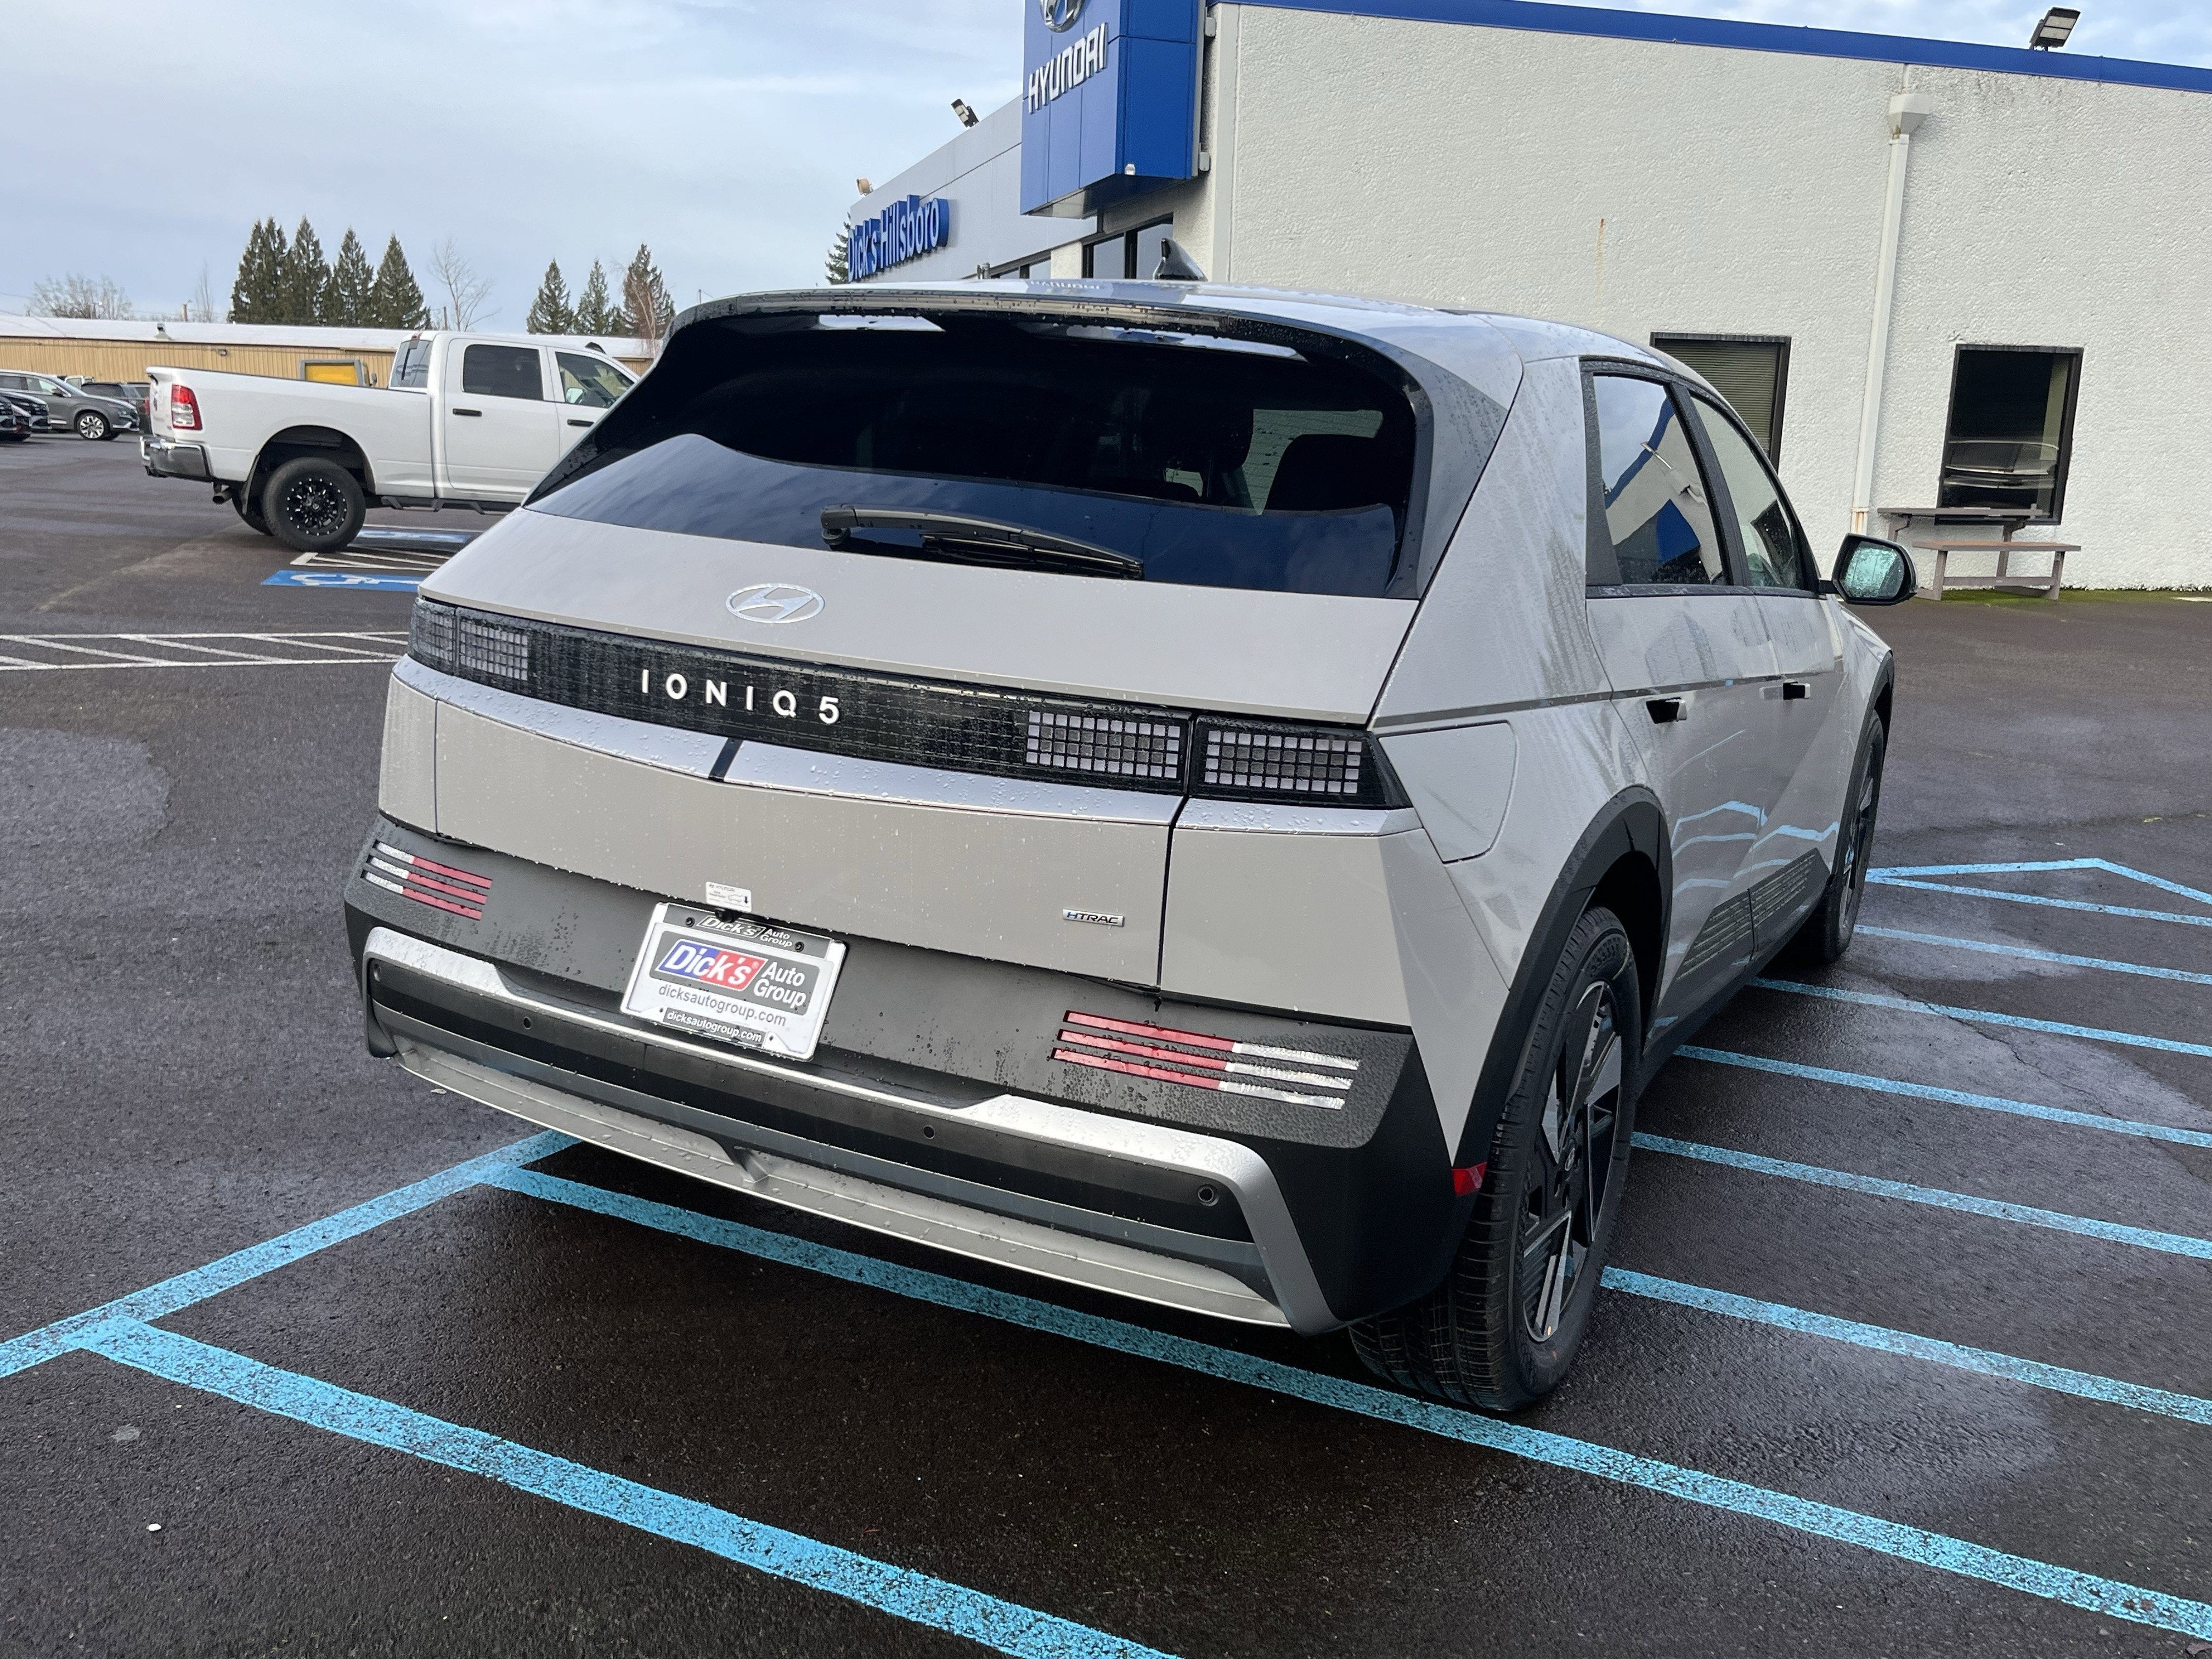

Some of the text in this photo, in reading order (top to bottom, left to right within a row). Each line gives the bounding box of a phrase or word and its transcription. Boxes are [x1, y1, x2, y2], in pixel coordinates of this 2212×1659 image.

[1028, 22, 1108, 114] HYUNDAI
[848, 194, 947, 283] Dick's Hillsboro
[641, 669, 839, 724] IONIQ 5
[702, 917, 791, 940] Dick's Auto
[1066, 912, 1119, 924] HTRAC
[760, 934, 793, 947] Group
[665, 944, 805, 987] Dick's Auto
[658, 984, 786, 1026] dicksautogroup.com
[754, 978, 806, 1009] Group
[667, 1011, 762, 1042] dicksautogroup.com
